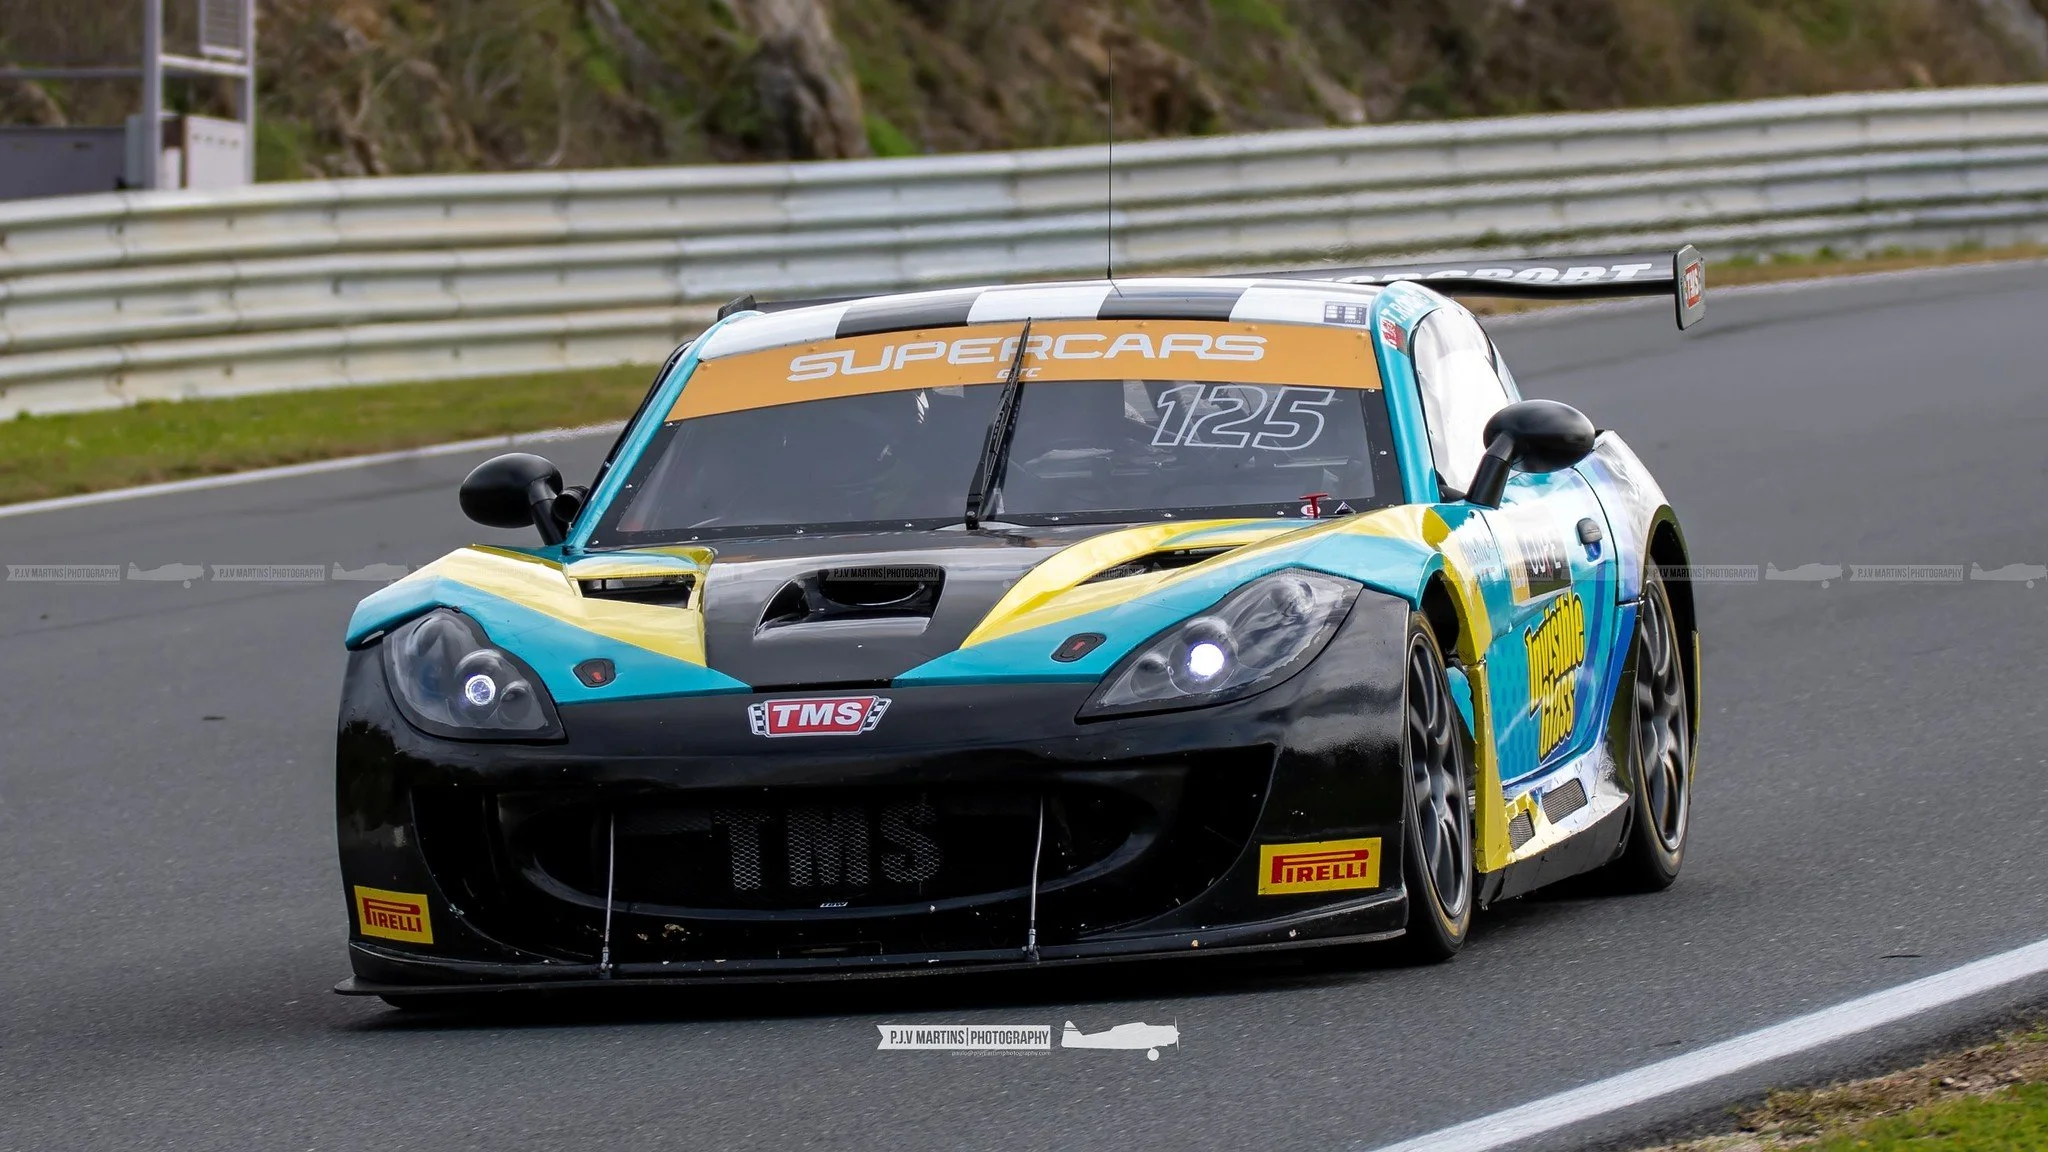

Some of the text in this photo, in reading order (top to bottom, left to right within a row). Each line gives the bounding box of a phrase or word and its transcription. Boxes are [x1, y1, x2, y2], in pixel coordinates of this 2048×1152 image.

[786, 333, 1268, 382] SUPERCARS
[1151, 384, 1336, 451] 125
[1525, 590, 1585, 716] Invisible
[771, 702, 863, 727] TMS
[1539, 671, 1576, 761] Glass
[713, 802, 943, 890] TMS
[1270, 849, 1370, 884] PIRELLI
[362, 897, 423, 933] PIRELLI
